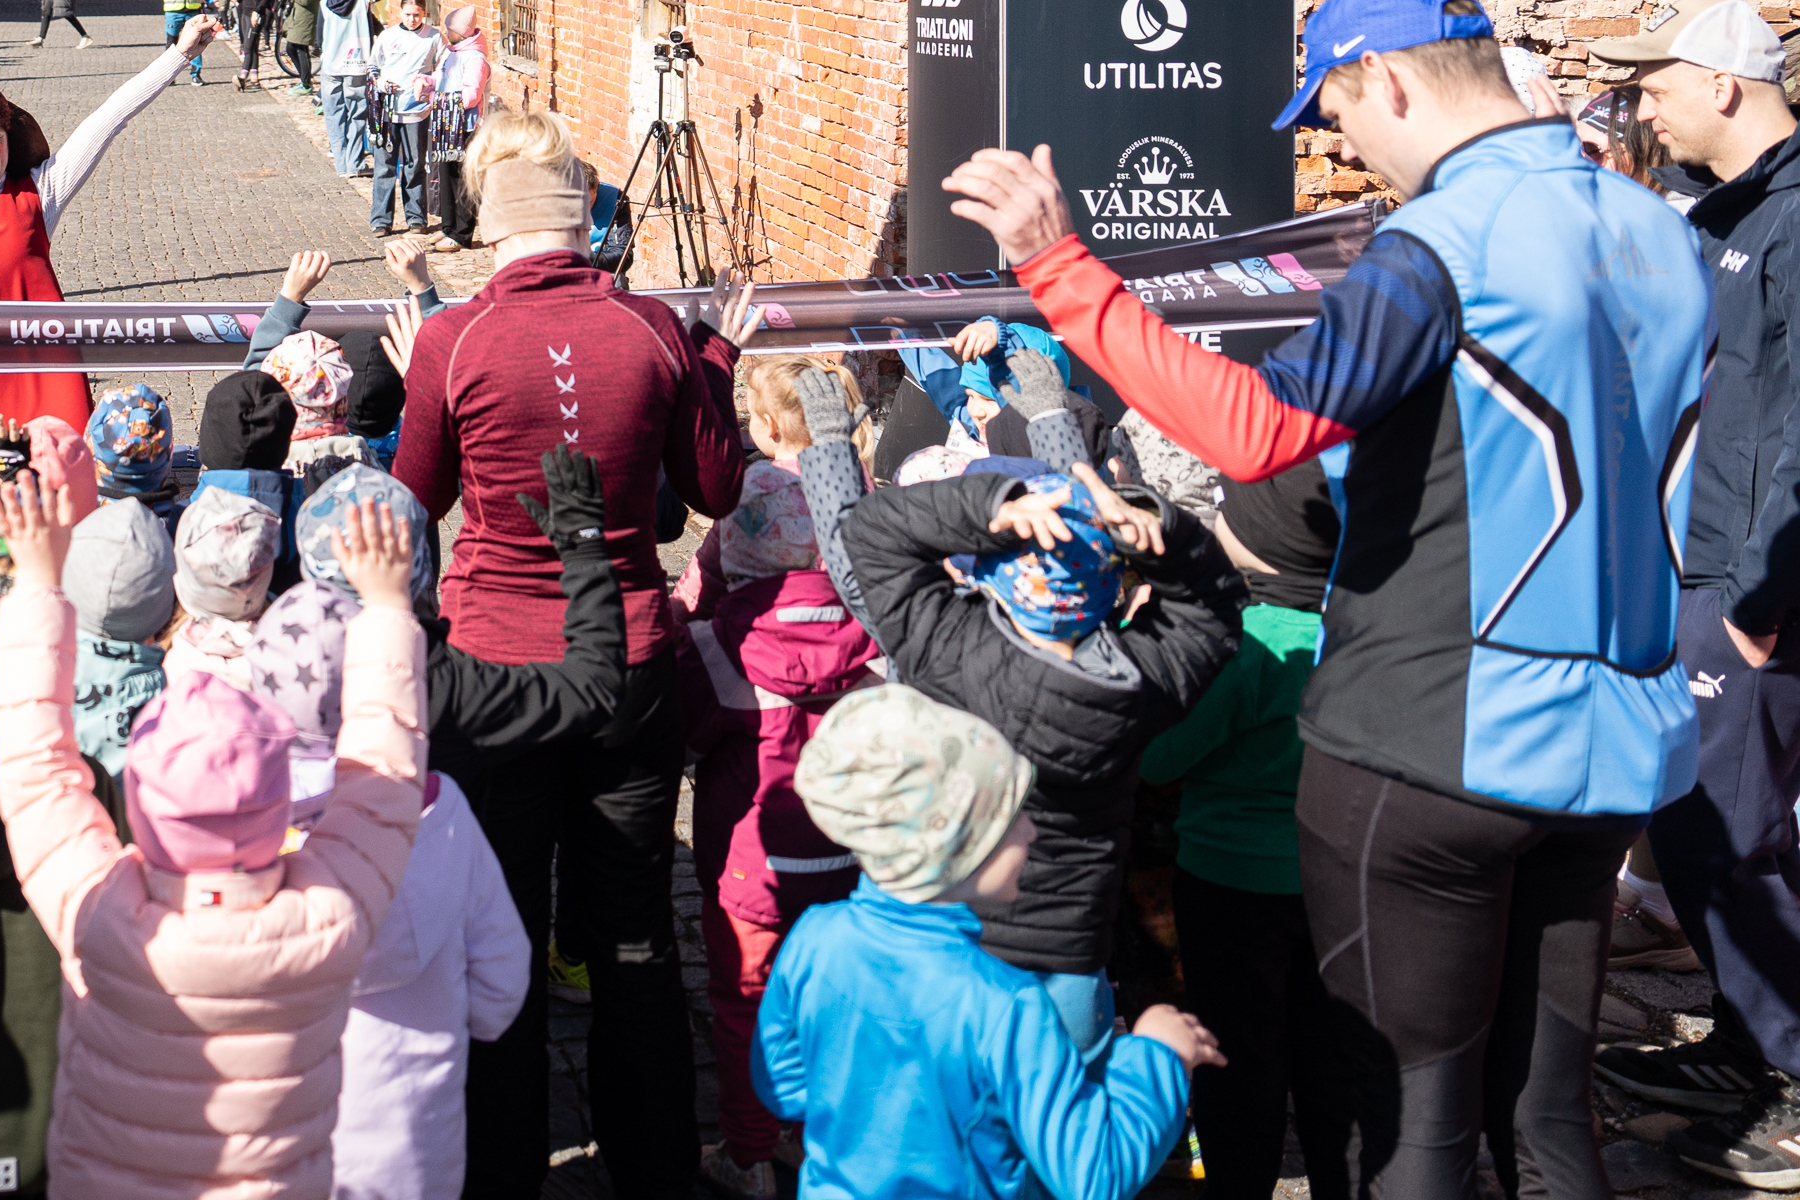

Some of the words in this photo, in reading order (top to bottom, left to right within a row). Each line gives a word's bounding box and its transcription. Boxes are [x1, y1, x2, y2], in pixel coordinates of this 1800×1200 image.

[916, 17, 973, 41] TRIATLONI
[916, 43, 973, 59] AKADEEMIA
[1084, 62, 1223, 89] UTILITAS
[1117, 136, 1149, 168] LOODUSLIK
[1151, 135, 1194, 167] MINERAALVESI
[1179, 172, 1195, 180] 1973
[1079, 182, 1232, 217] VÄRSKA
[1091, 222, 1220, 240] ORIGINAAL
